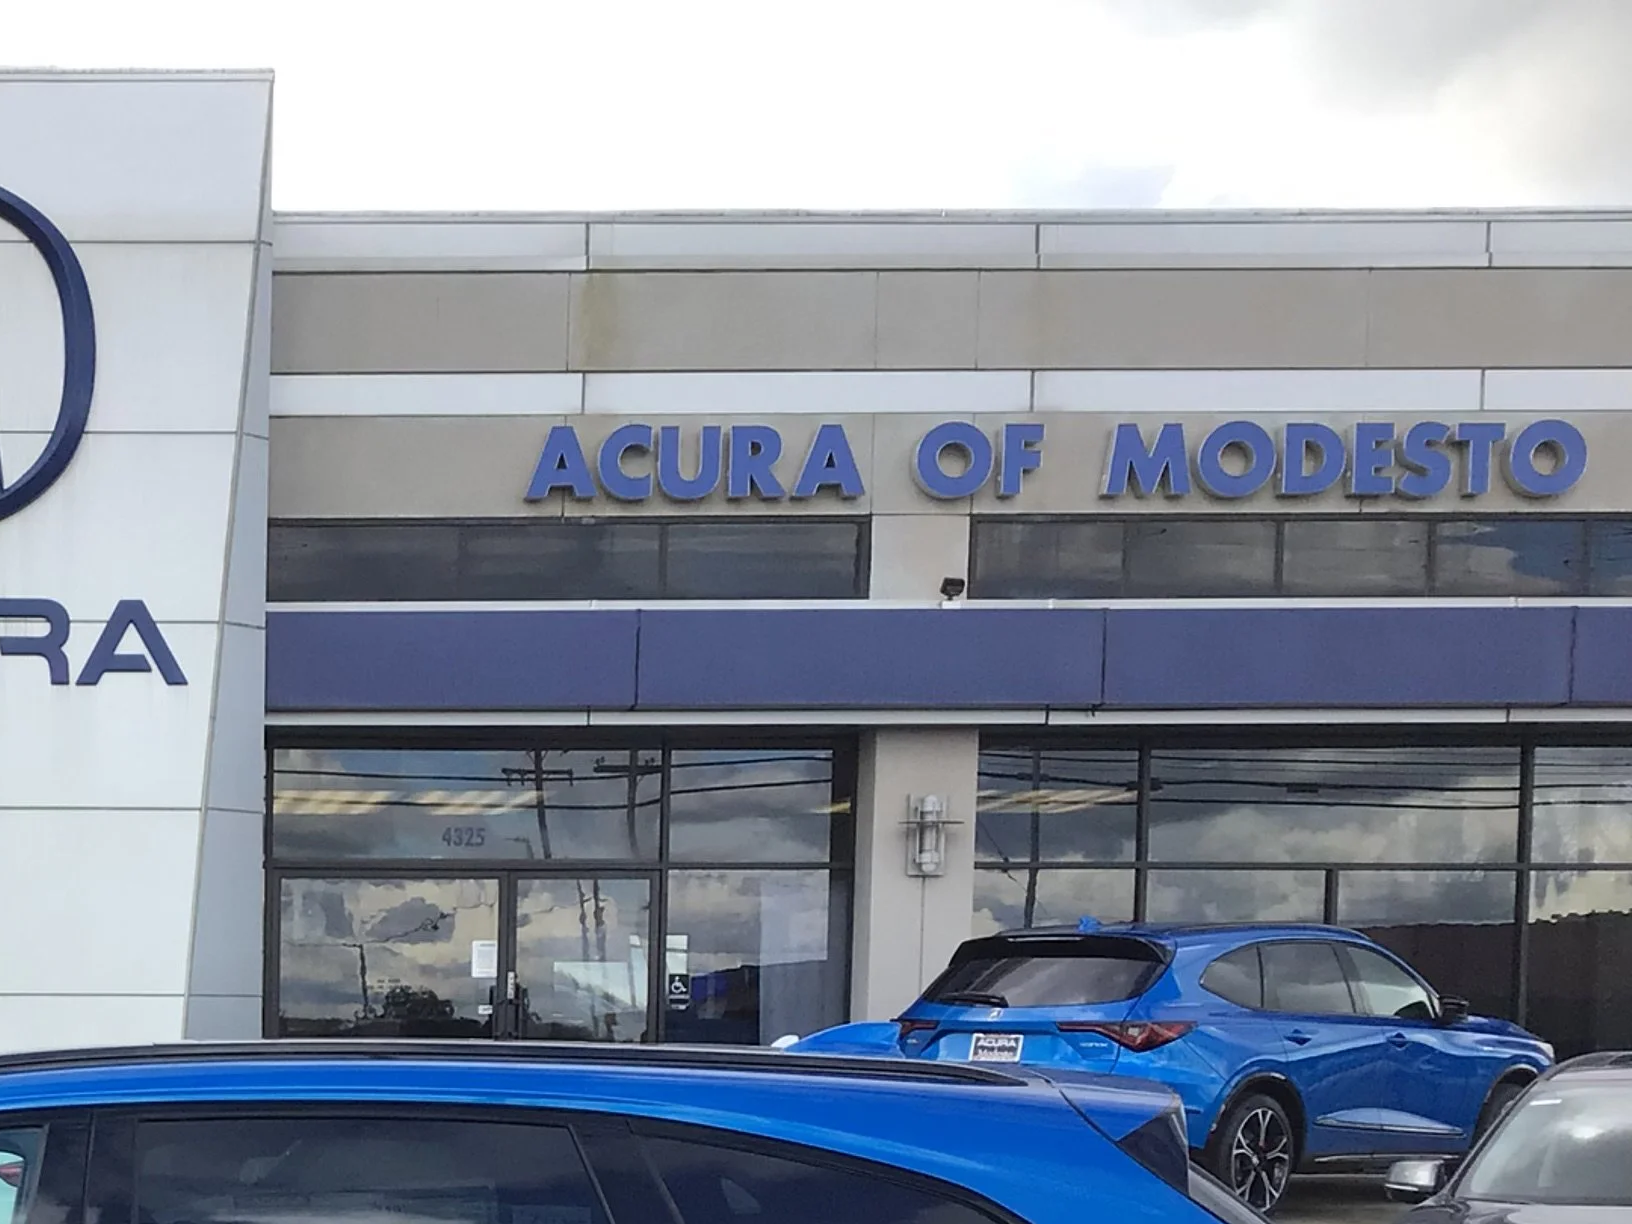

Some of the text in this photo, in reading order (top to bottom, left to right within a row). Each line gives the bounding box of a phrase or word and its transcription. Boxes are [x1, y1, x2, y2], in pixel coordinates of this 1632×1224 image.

[524, 418, 1588, 500] ACURA OF MODESTO
[442, 827, 486, 847] 4325
[976, 1038, 1017, 1047] ACURA
